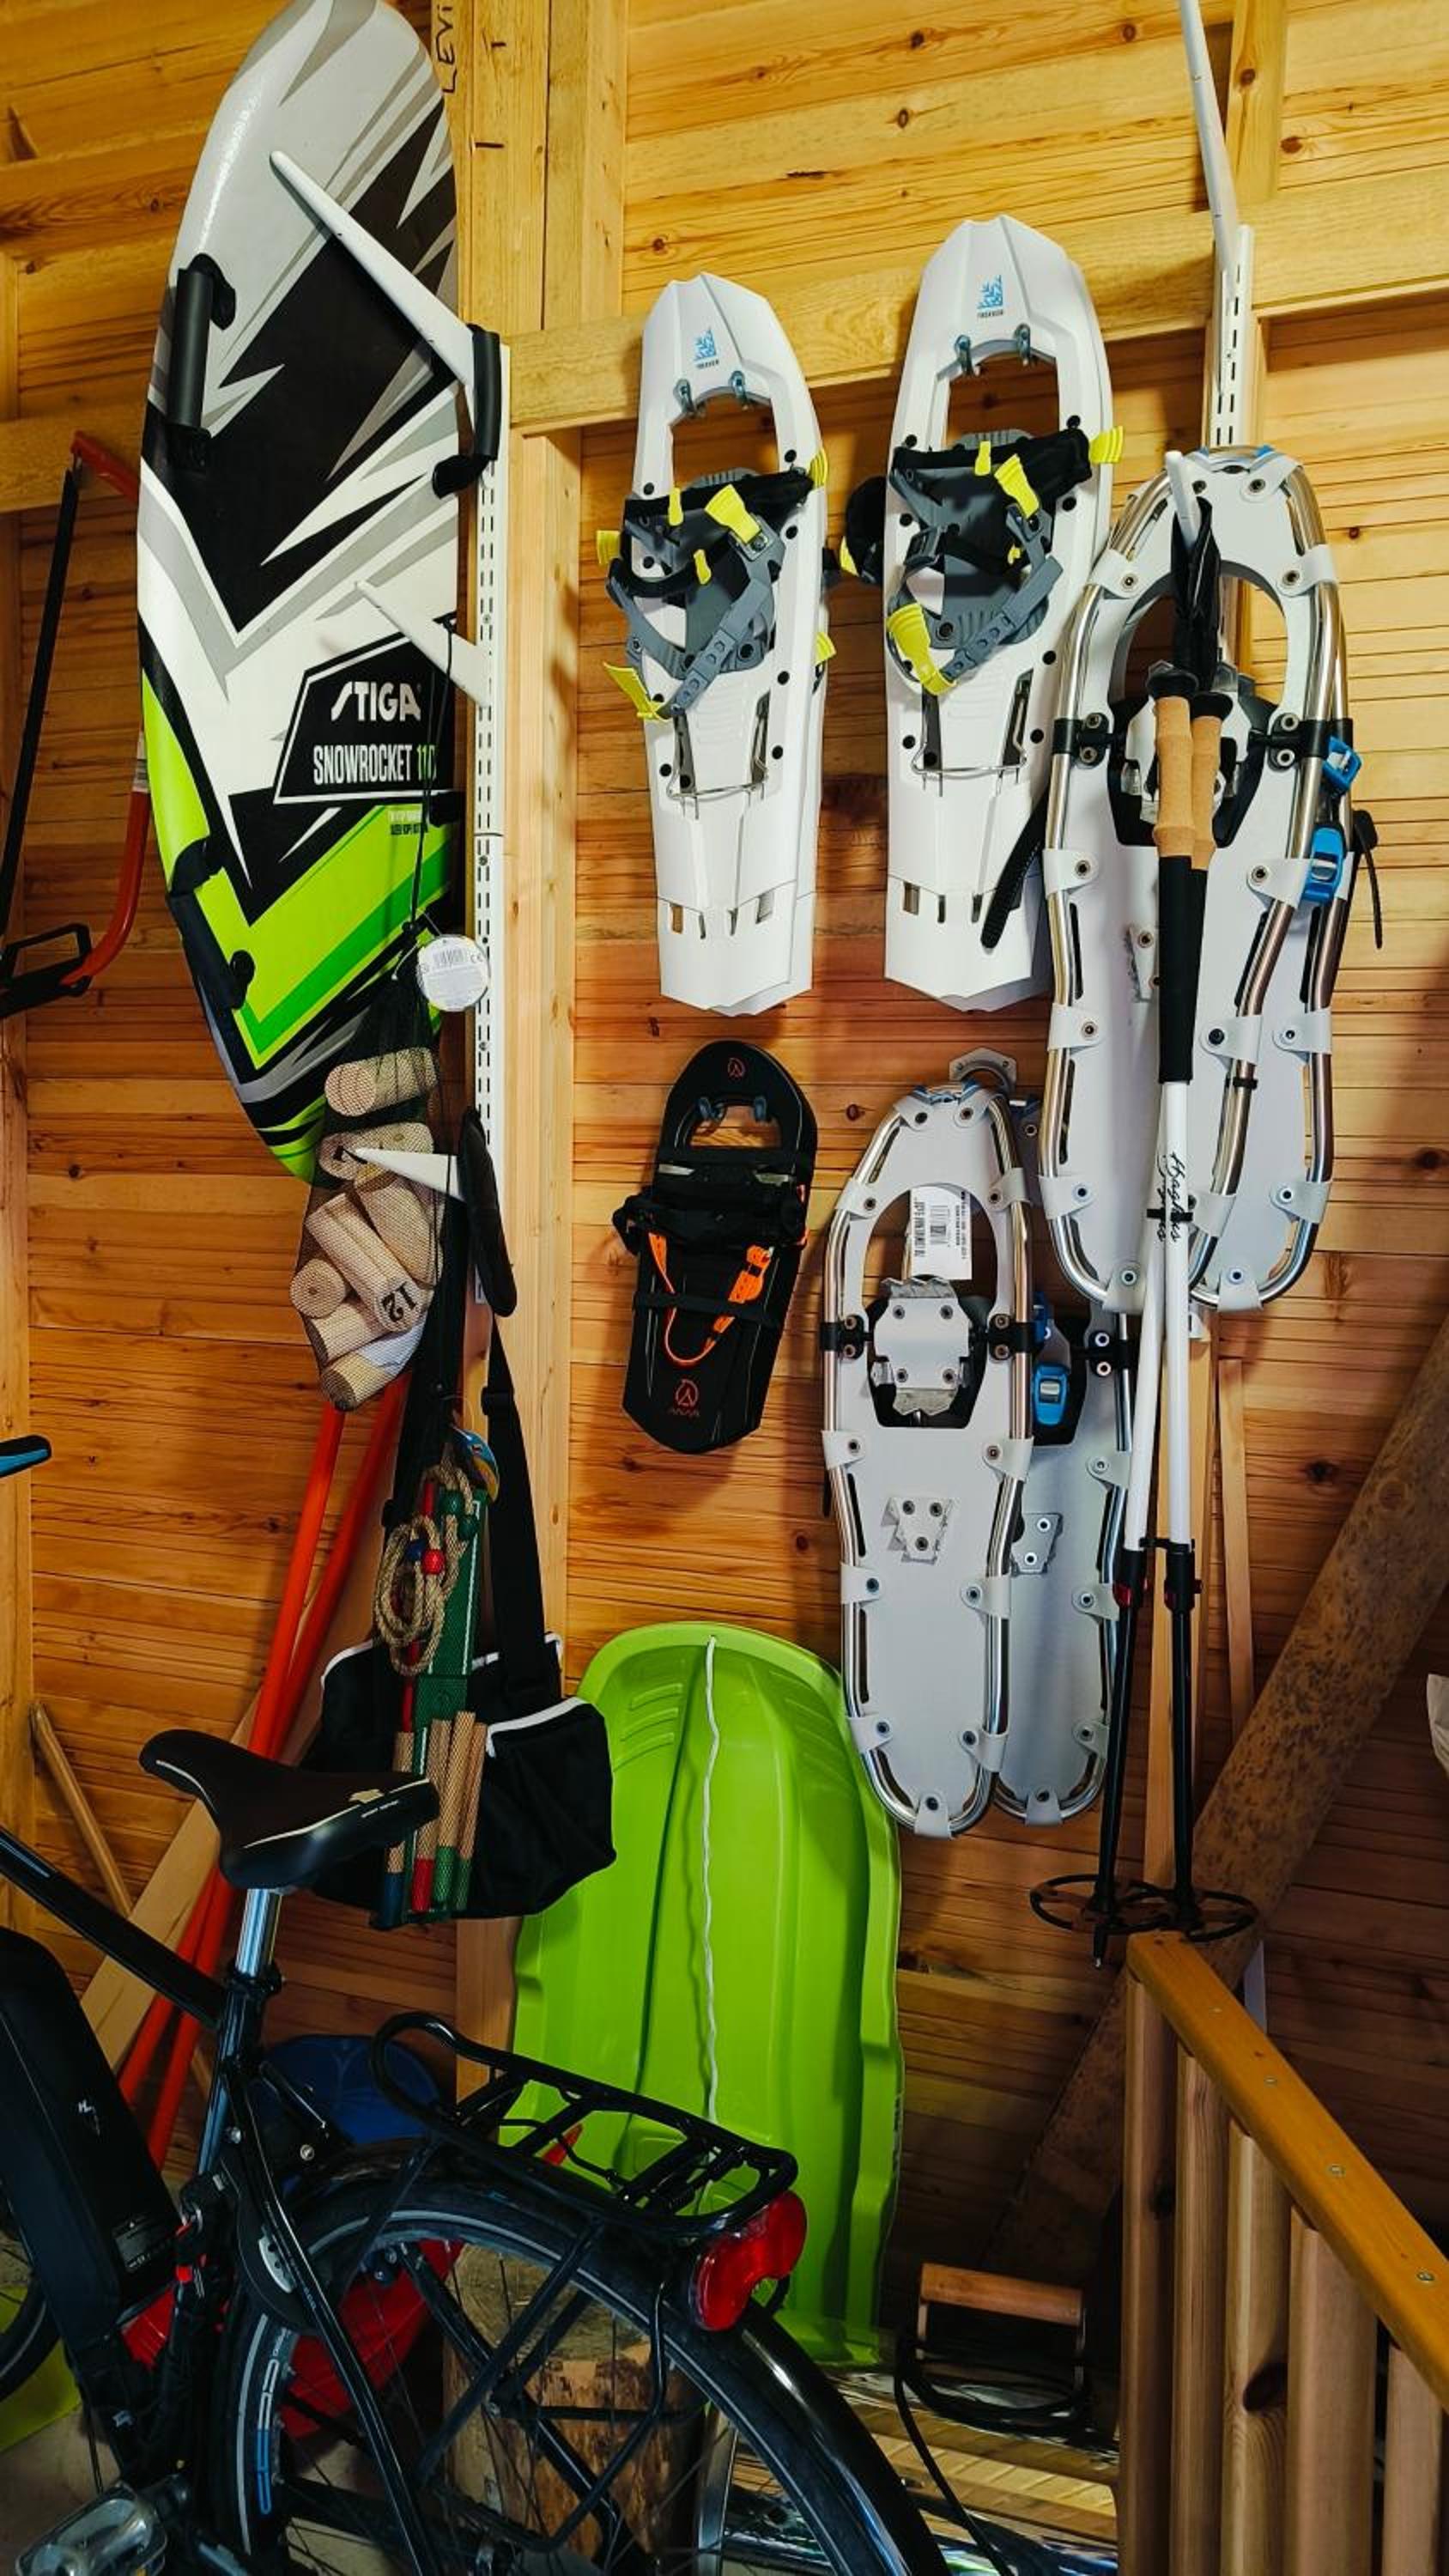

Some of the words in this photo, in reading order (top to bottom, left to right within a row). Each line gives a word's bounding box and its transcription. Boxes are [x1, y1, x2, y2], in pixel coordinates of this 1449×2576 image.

[330, 681, 421, 721] STIGA
[313, 744, 412, 785] SNOWROCKET
[381, 1281, 416, 1322] 12
